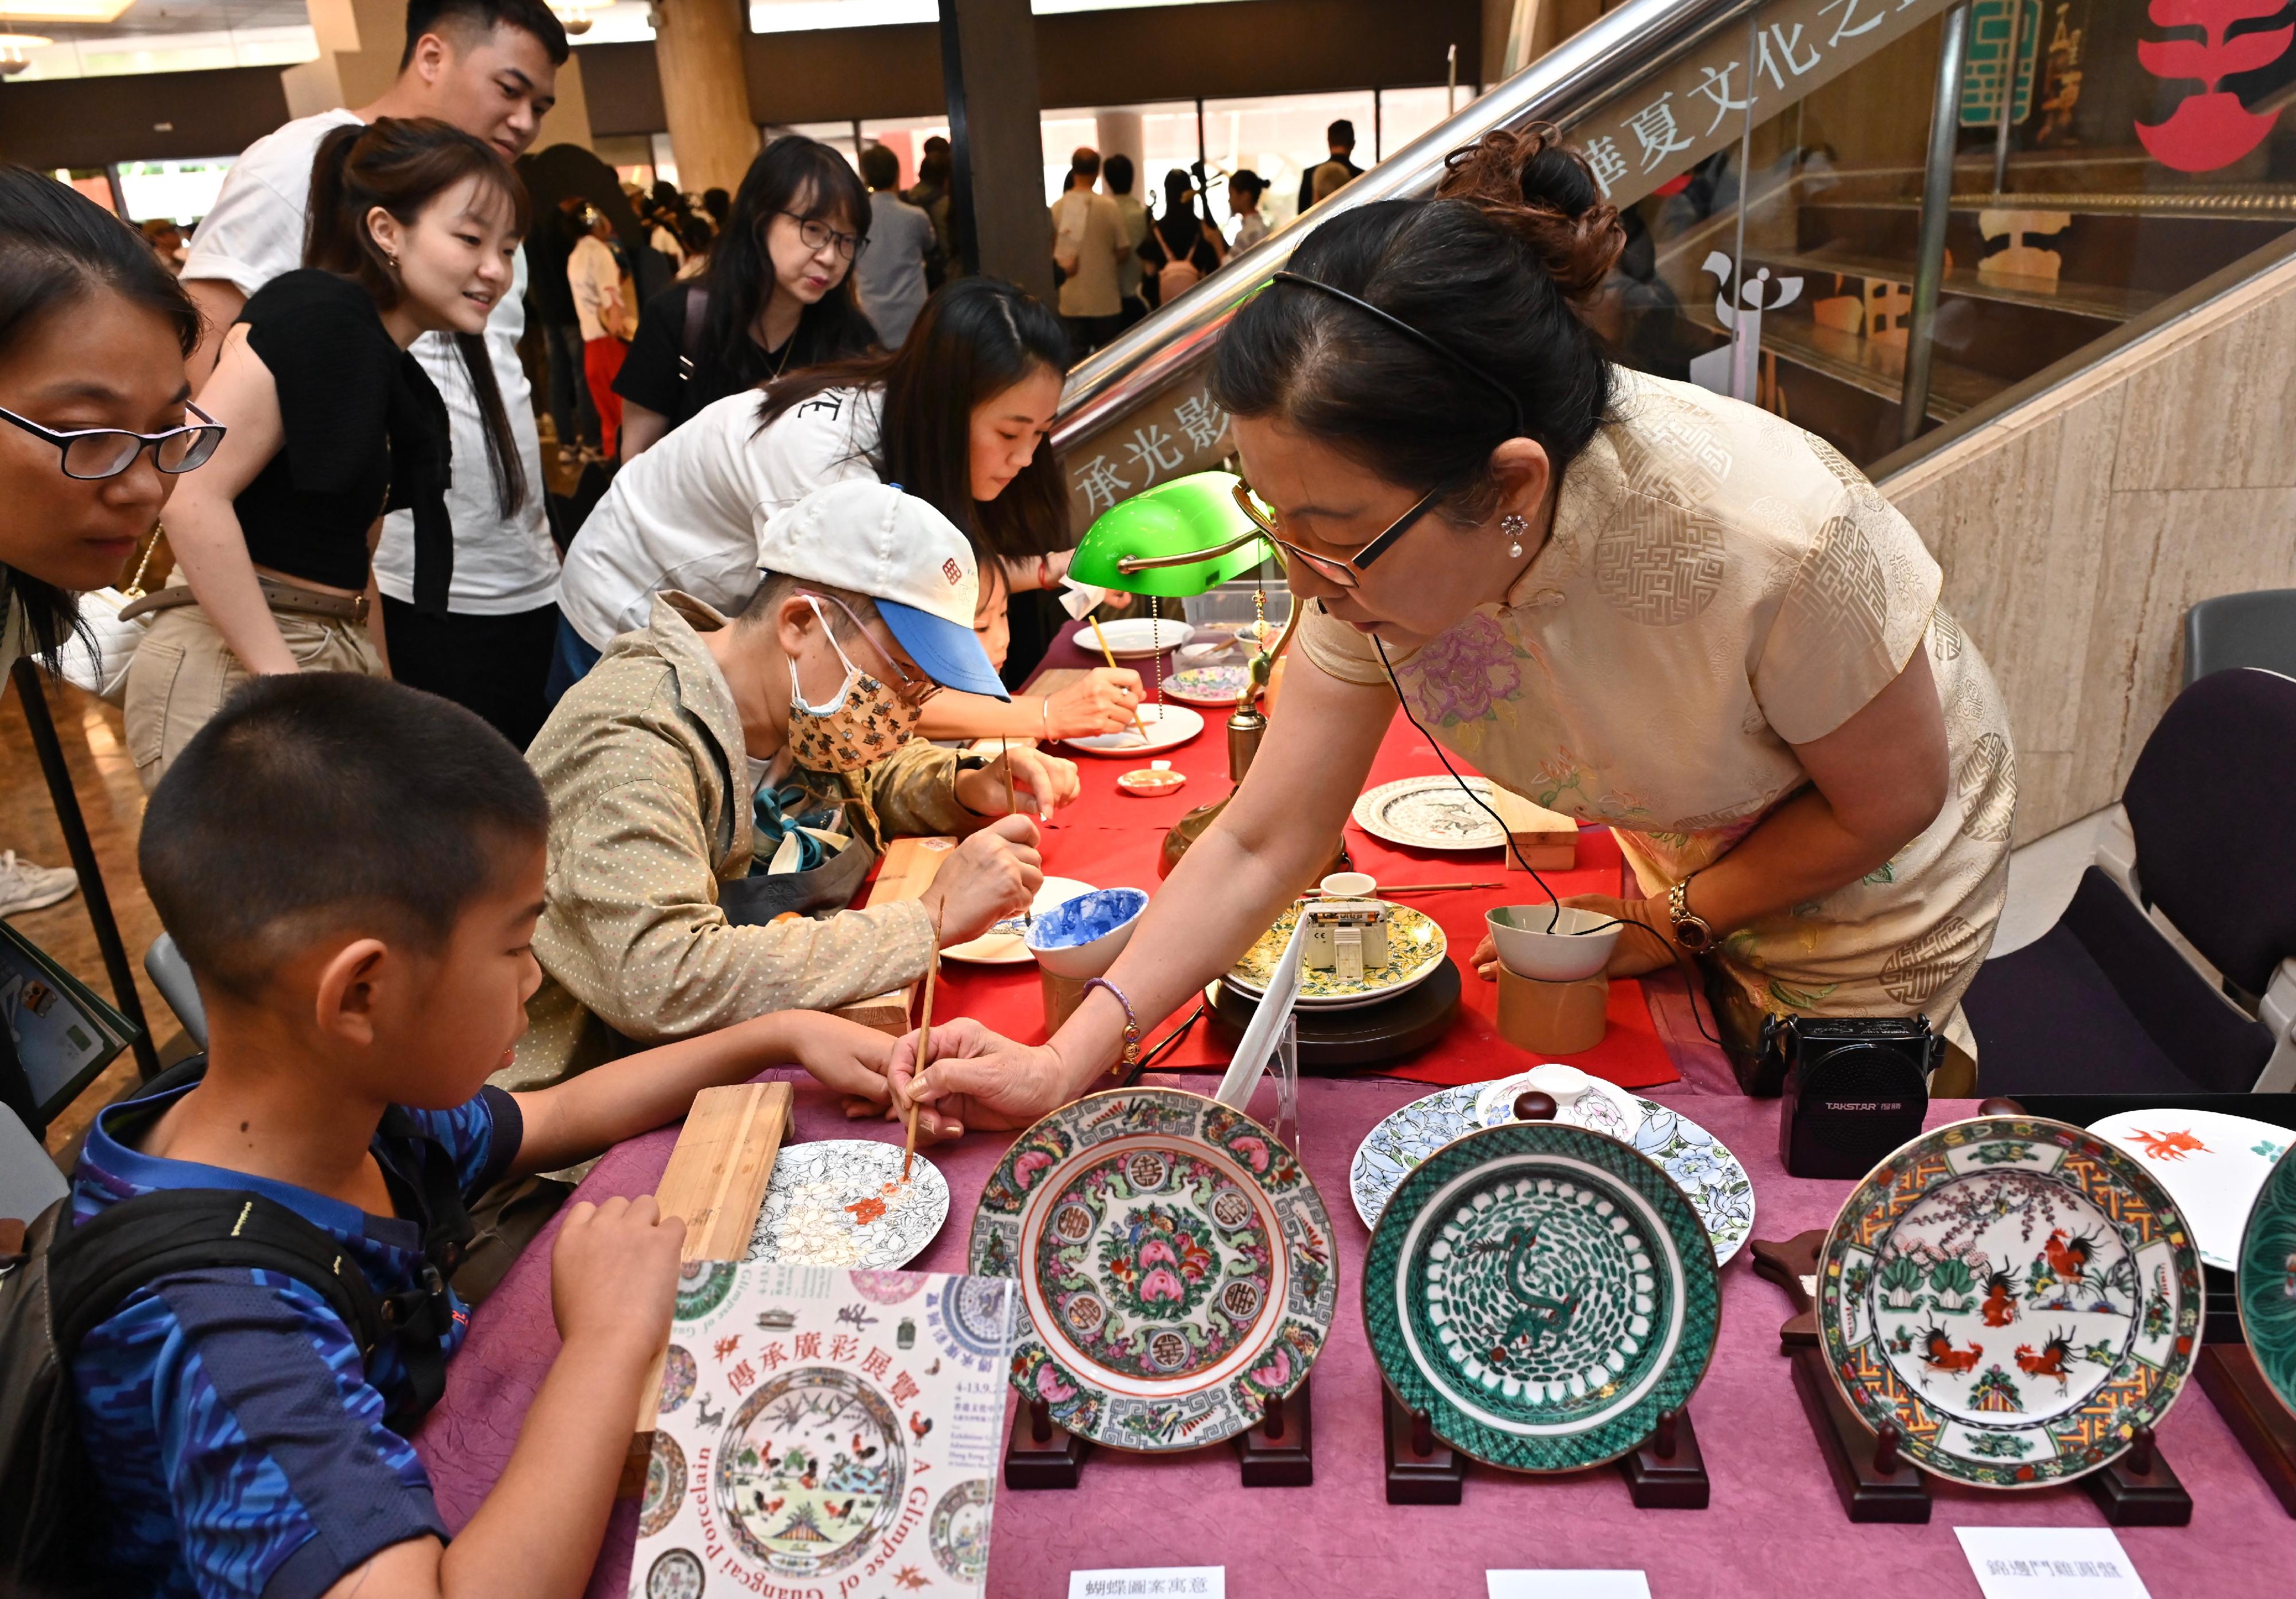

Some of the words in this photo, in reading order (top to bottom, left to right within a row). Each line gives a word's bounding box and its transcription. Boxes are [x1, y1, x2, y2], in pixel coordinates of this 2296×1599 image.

[1583, 0, 1918, 200] 華夏文化之
[1825, 1102, 1878, 1110] TAKSTAR
[727, 1331, 922, 1408] 傳承廣彩展覽
[913, 1458, 932, 1476] A
[689, 1446, 726, 1562] Porcelain
[864, 1486, 929, 1577] Glimpse
[719, 1557, 825, 1599] Guangcai
[838, 1574, 860, 1599] of
